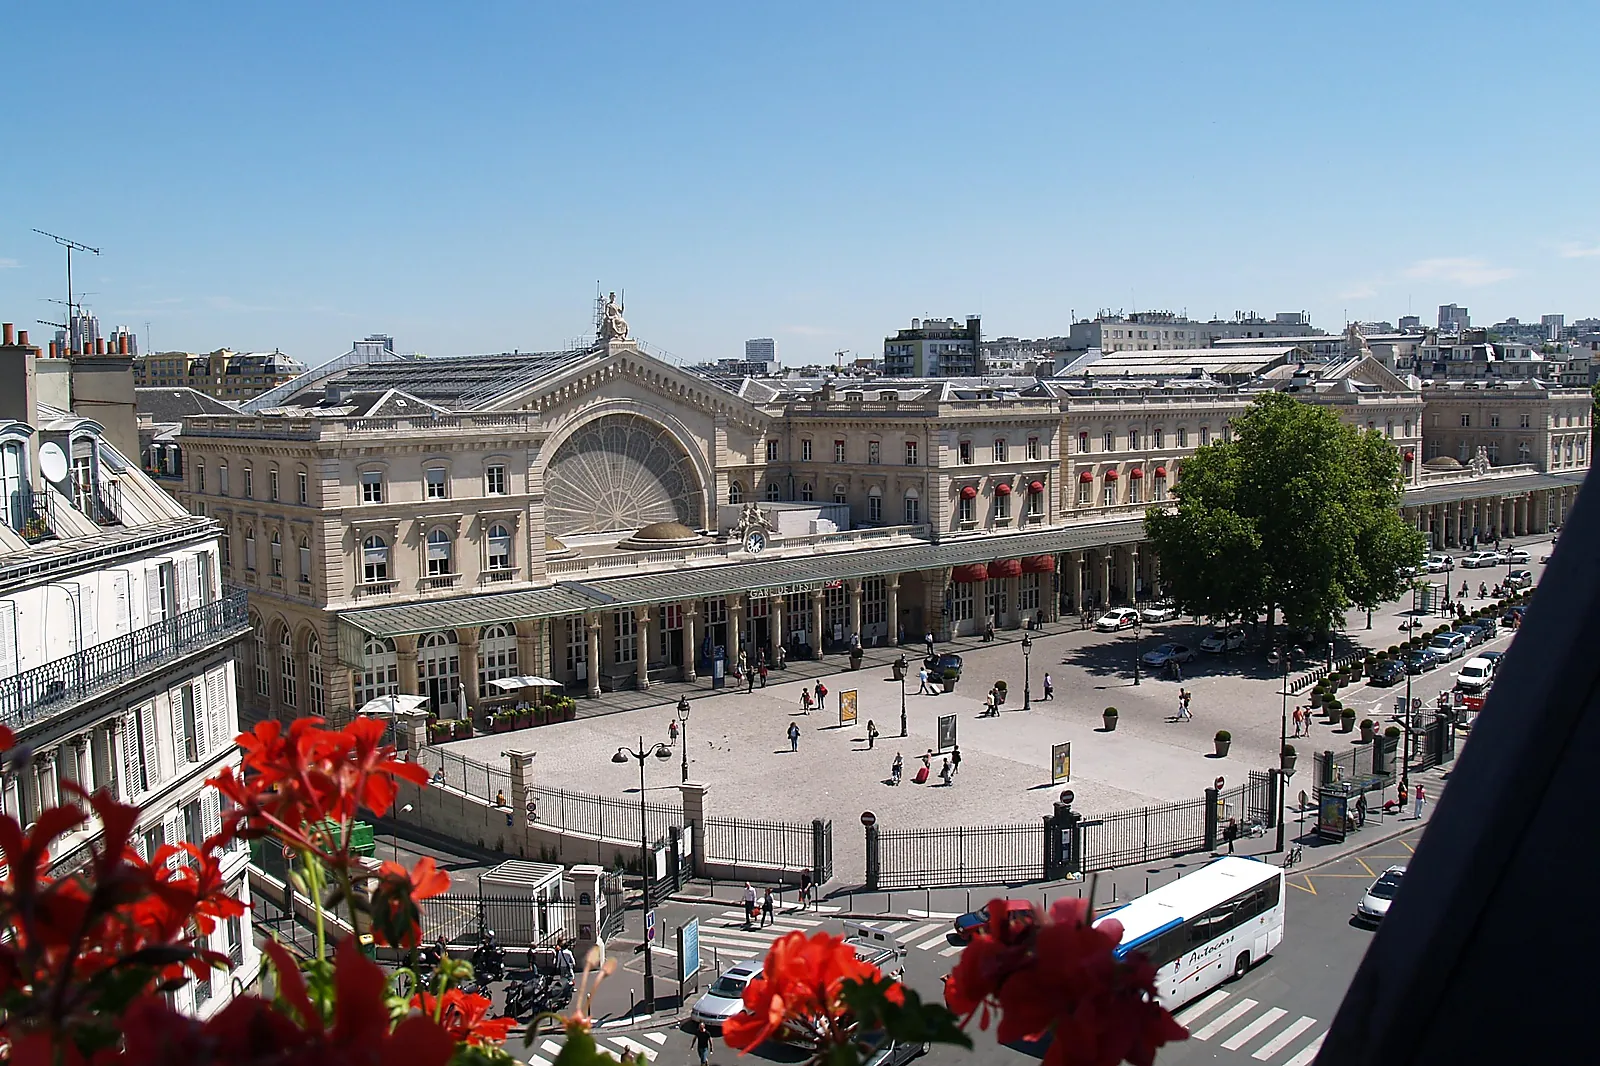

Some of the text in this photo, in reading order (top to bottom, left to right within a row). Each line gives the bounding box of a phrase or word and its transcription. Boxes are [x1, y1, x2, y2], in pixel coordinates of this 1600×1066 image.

[750, 588, 774, 598] GARE
[778, 585, 789, 595] DE
[1189, 935, 1235, 965] Autocars
